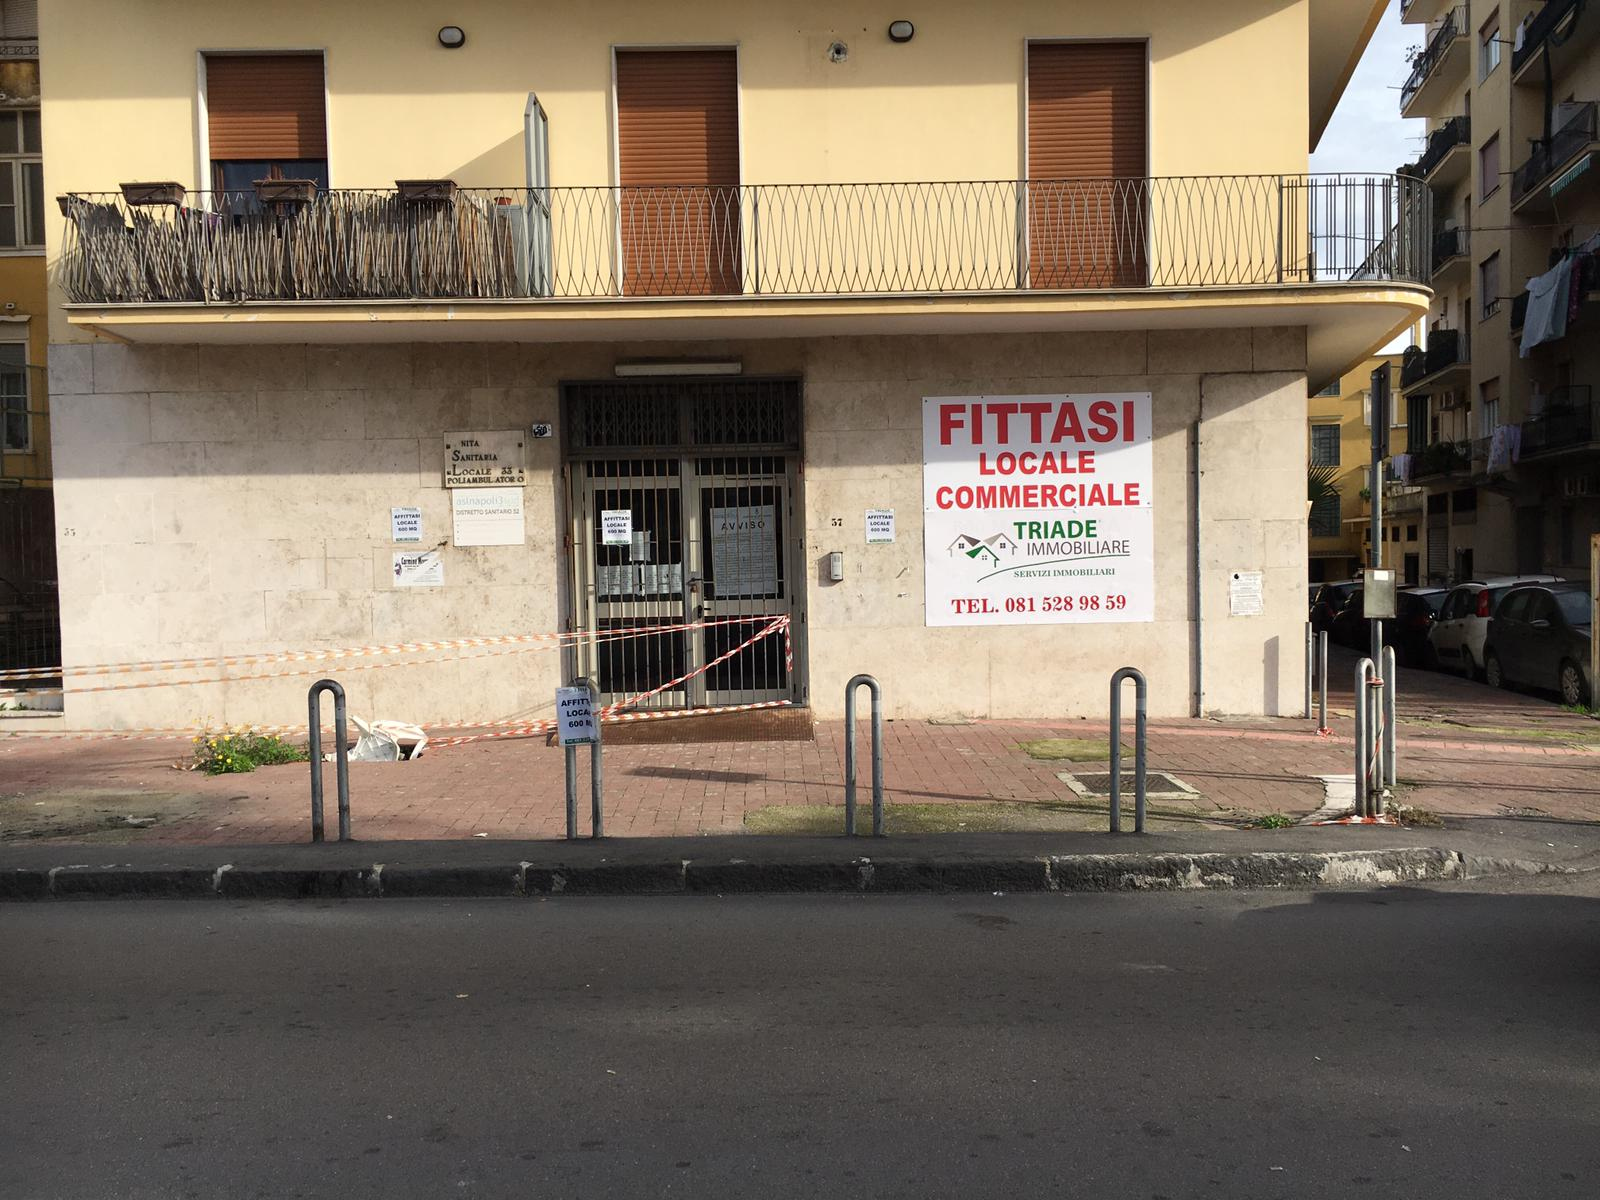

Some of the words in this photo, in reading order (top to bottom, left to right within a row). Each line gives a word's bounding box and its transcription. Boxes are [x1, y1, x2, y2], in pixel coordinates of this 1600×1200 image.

[940, 401, 1134, 445] FITTASI
[452, 450, 498, 461] SANITARIA
[452, 464, 491, 476] LOCALE
[501, 466, 512, 475] 33
[979, 451, 1095, 475] LOCALE
[936, 483, 1140, 509] COMMERCIALE
[721, 520, 765, 530] AVVISO
[831, 518, 842, 526] 57
[1013, 519, 1098, 540] TRIADE
[1027, 540, 1130, 556] IMMOBILIARE
[1014, 569, 1050, 578] SERVIZI
[1053, 568, 1115, 577] IMMOBILIARI
[951, 598, 999, 614] TEL.
[1005, 597, 1035, 612] 081
[1042, 596, 1073, 612] 528
[1079, 595, 1100, 611] 98
[1105, 594, 1126, 610] 59
[568, 720, 583, 728] 600
